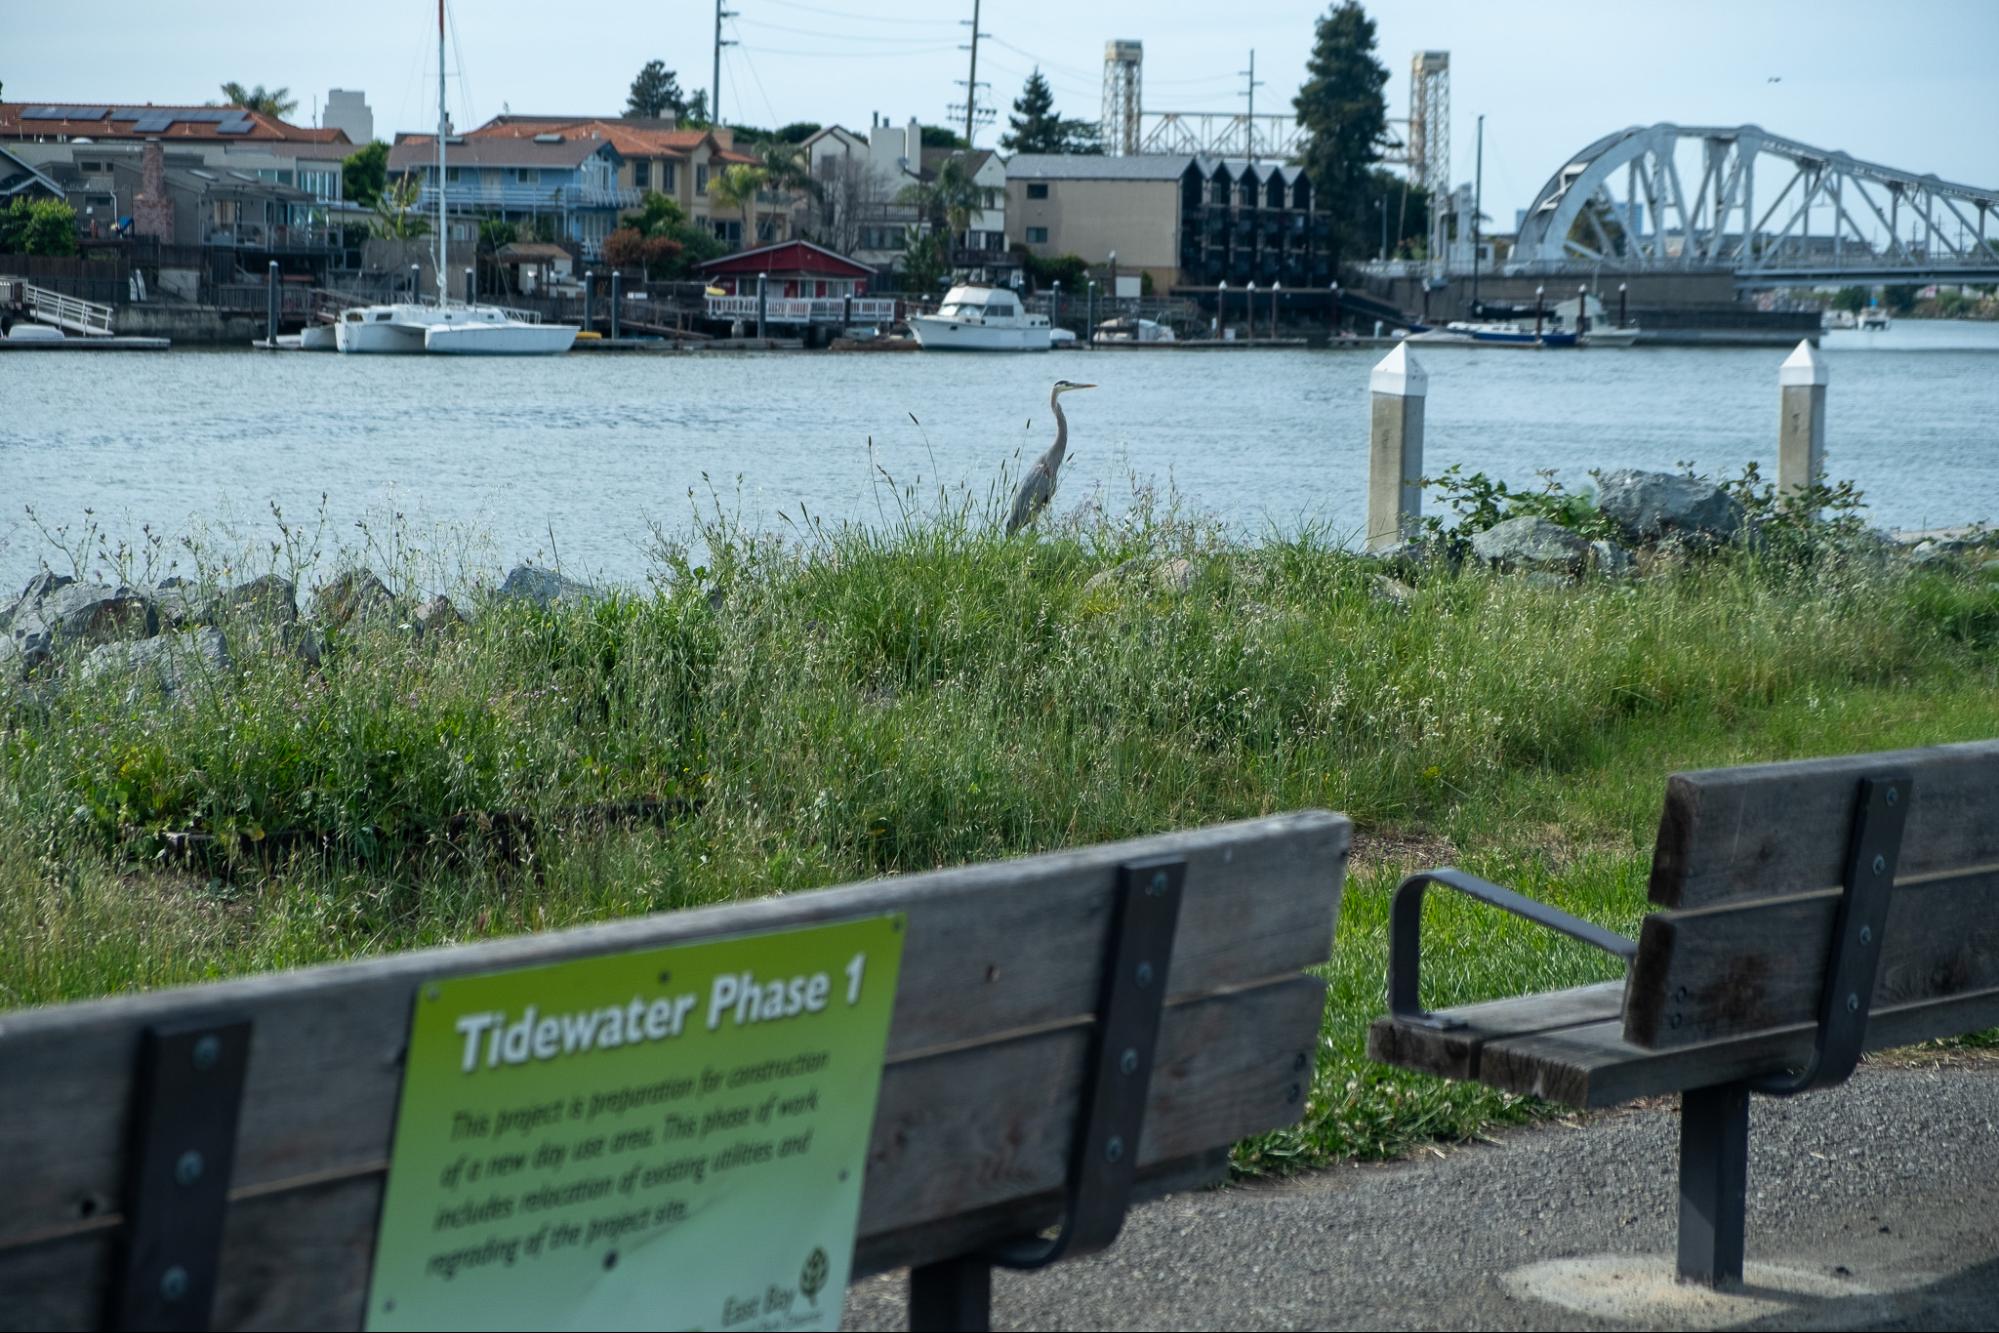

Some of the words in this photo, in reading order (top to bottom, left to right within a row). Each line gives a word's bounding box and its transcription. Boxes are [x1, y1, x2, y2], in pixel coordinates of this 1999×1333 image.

[456, 993, 697, 1073] Tidewater
[707, 968, 829, 1030] Phase
[845, 952, 866, 1005] 1
[440, 1153, 467, 1190] of
[466, 1160, 481, 1182] a
[486, 1154, 525, 1176] new
[532, 1142, 567, 1172] day
[571, 1138, 605, 1161] use
[663, 1113, 697, 1141] This
[699, 1106, 752, 1140] phase
[754, 1091, 778, 1127] of
[778, 1088, 819, 1118] work
[451, 1109, 490, 1140] This
[492, 1100, 565, 1140] project
[569, 1095, 583, 1120] is
[586, 1077, 695, 1124] preparation
[696, 1064, 724, 1098] for
[726, 1051, 830, 1089] construction
[433, 1193, 514, 1231] includes
[520, 1177, 614, 1213] relocation
[617, 1162, 642, 1195] of
[642, 1157, 707, 1188] existing
[711, 1140, 773, 1172] utilities
[777, 1127, 814, 1158] and
[425, 1234, 520, 1281] regrading
[524, 1223, 549, 1258] of
[550, 1222, 581, 1248] the
[586, 1207, 650, 1246] project
[722, 1295, 760, 1327] East
